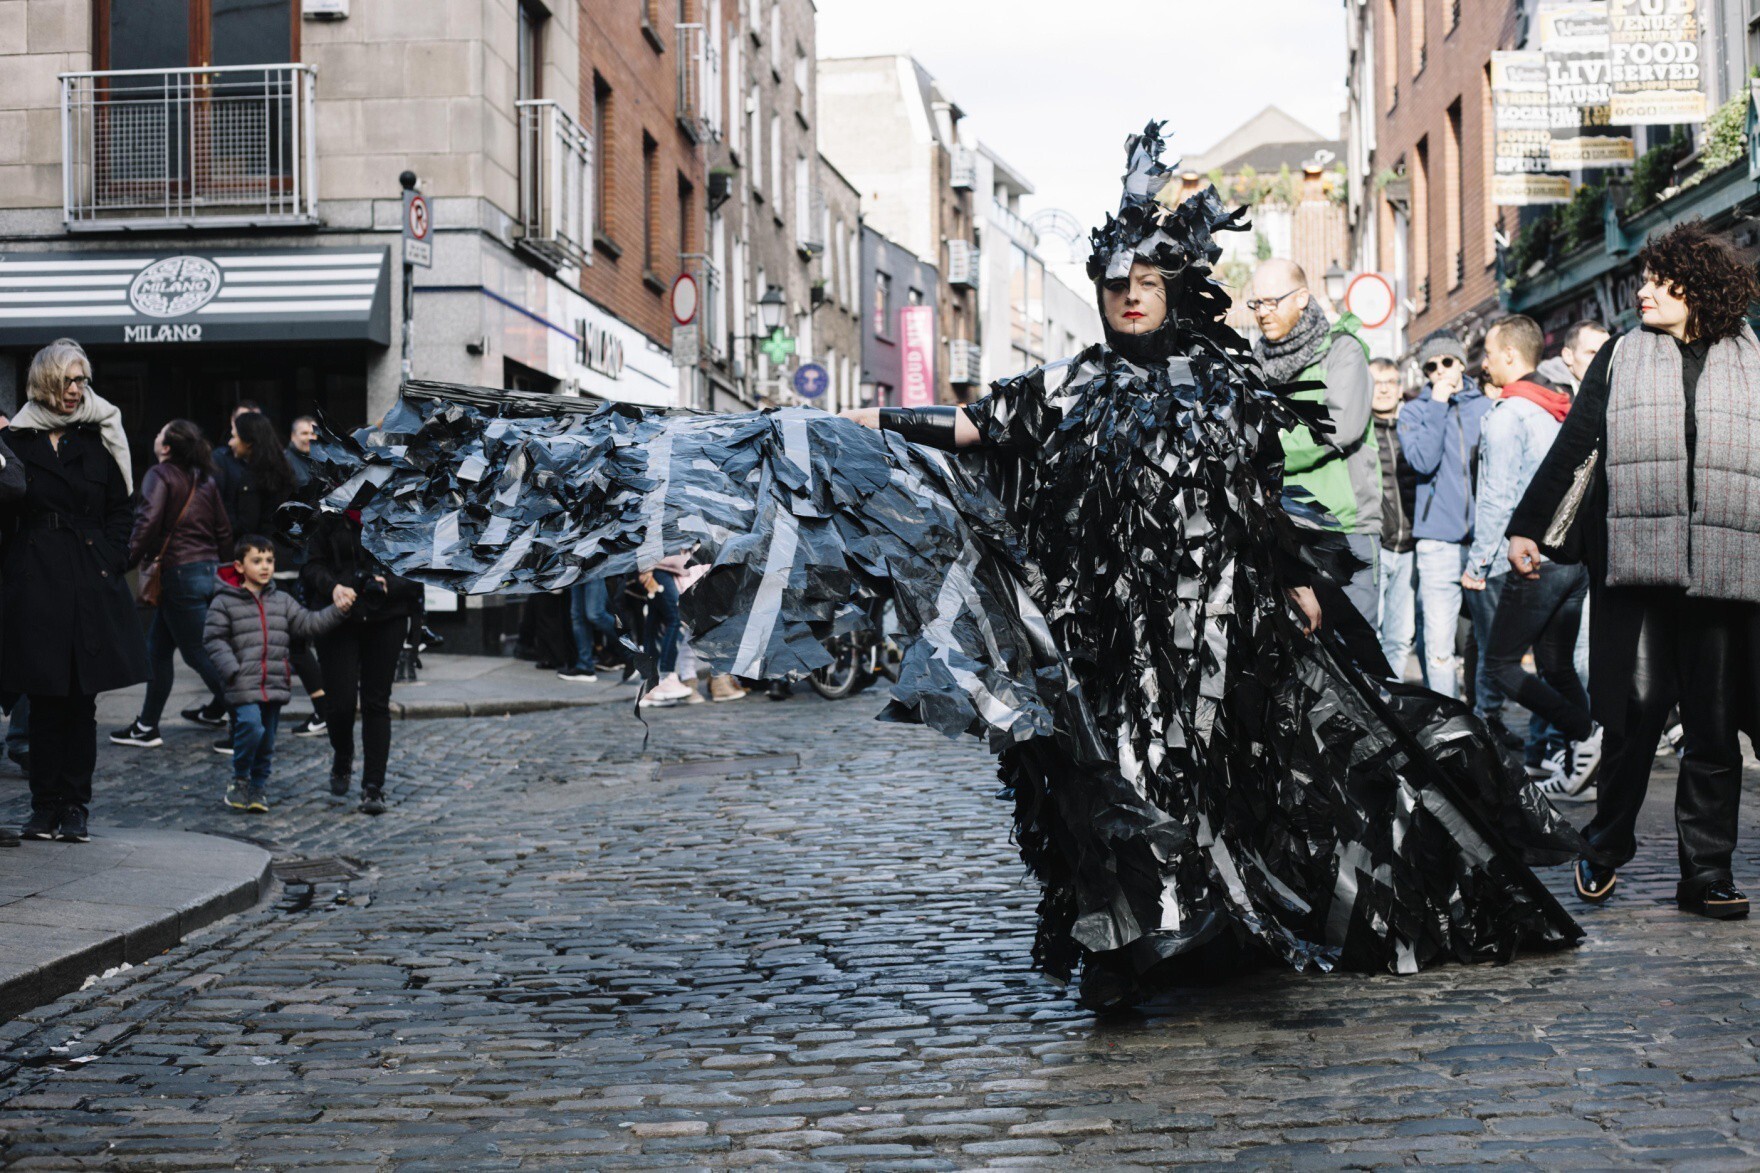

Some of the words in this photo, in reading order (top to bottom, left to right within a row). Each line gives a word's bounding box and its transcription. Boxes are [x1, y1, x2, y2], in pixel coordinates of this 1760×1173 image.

[1610, 14, 1677, 31] VENUE
[1611, 41, 1698, 65] FOOD
[1612, 63, 1699, 82] SERVED
[141, 280, 208, 293] MILANO
[124, 324, 202, 343] MILANO
[907, 350, 928, 400] CLOUD
